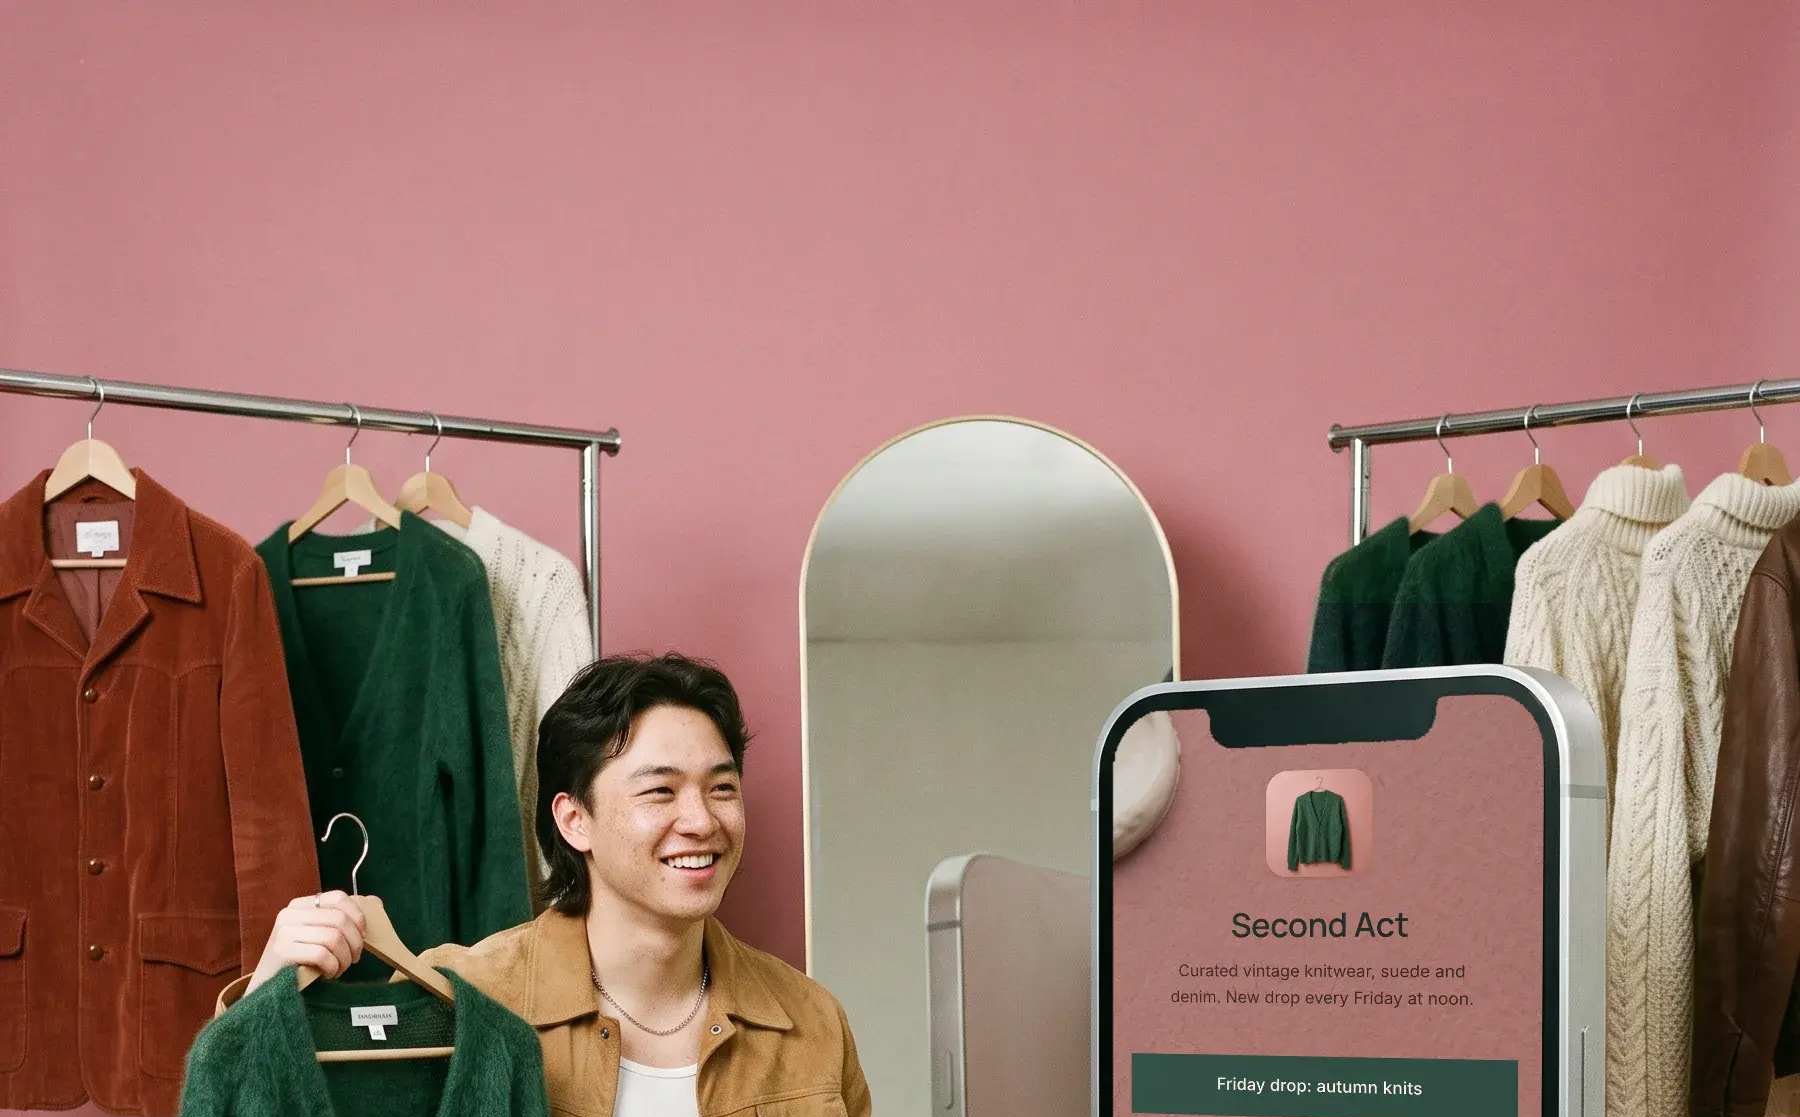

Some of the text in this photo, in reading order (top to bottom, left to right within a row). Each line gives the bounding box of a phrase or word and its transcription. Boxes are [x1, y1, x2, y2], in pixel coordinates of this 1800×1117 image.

[1231, 911, 1409, 939] Second Act
[1178, 963, 1466, 982] Curated vintage knitwear, suede and
[1170, 989, 1475, 1009] denim. New drop every Friday at noon.
[1217, 1076, 1423, 1096] Friday drop: autumn knits
